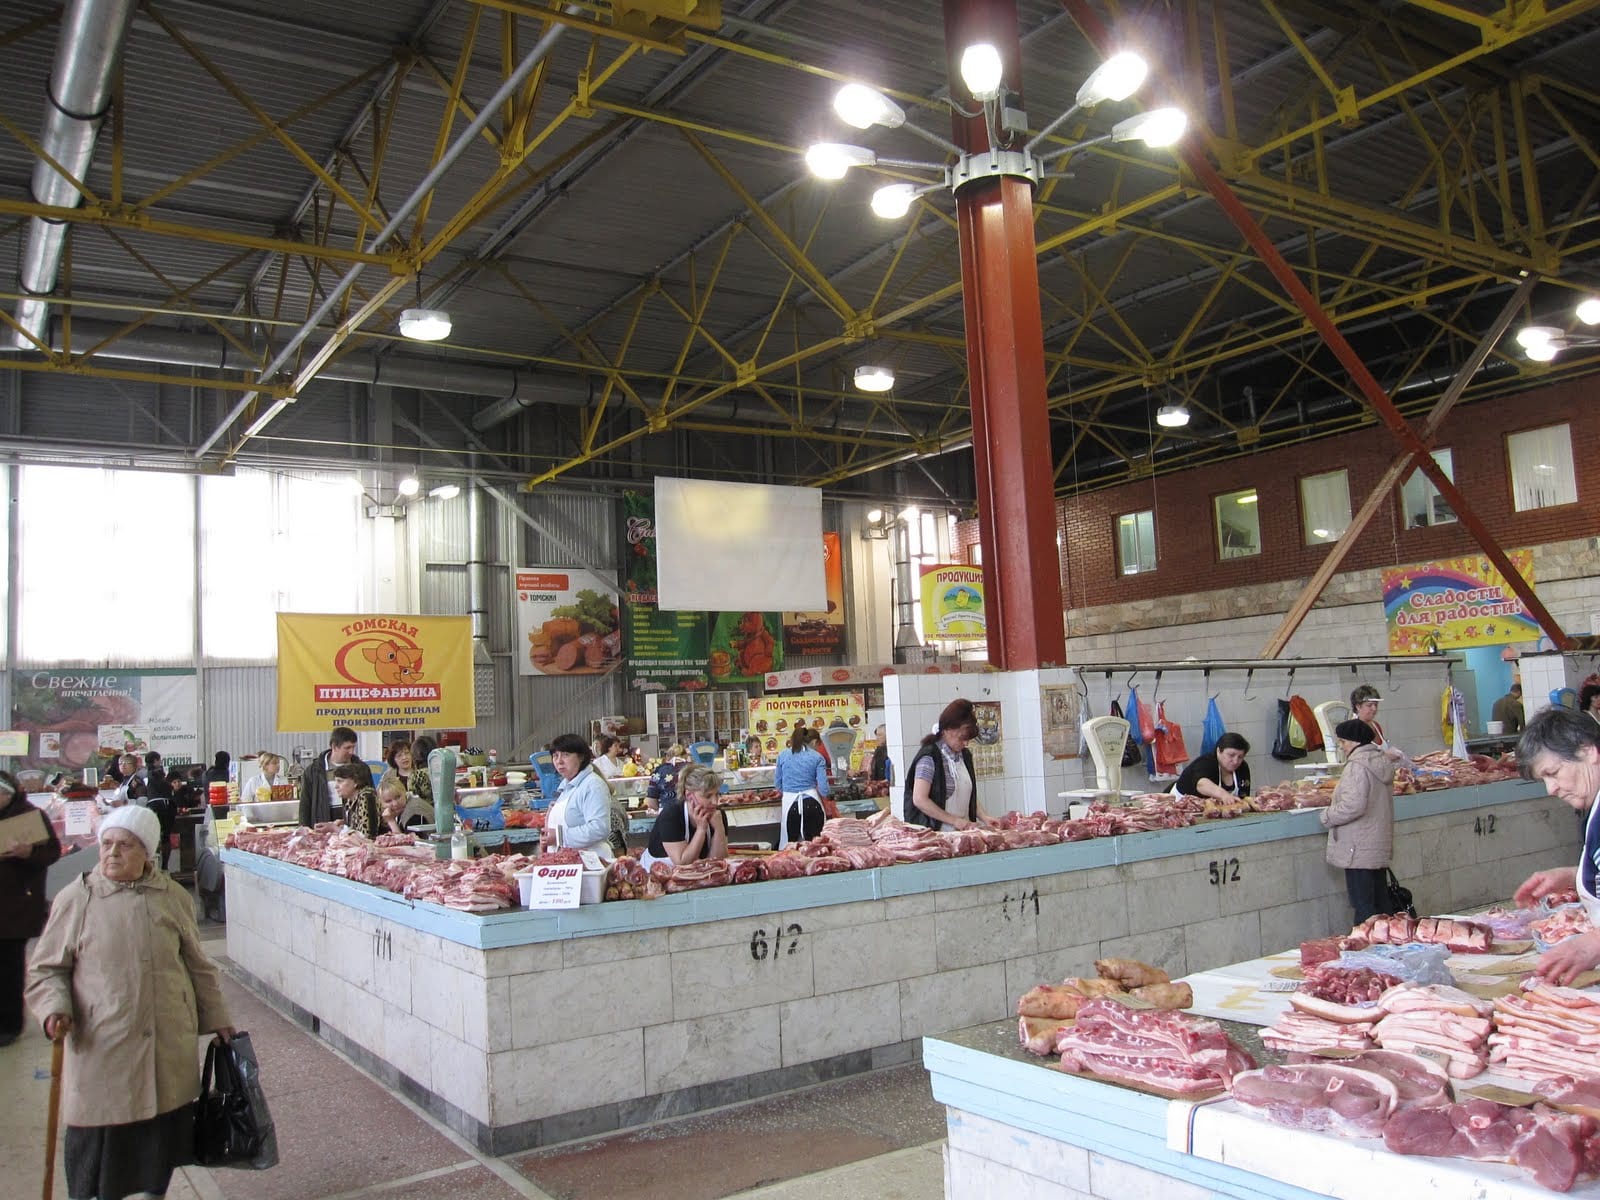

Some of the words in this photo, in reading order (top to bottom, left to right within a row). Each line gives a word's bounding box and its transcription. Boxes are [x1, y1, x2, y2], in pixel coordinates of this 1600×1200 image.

[1410, 586, 1502, 608] Сладости
[1396, 611, 1431, 626] для
[1435, 599, 1522, 625] радости!
[341, 618, 420, 638] ТОМСКАЯ
[31, 671, 118, 690] Свежие
[61, 687, 133, 697] впечатления!
[319, 687, 437, 701] ПТИЦЕФАБРИКА
[316, 707, 383, 717] ПРОДУКЦИЯ
[386, 706, 401, 715] ПО
[404, 705, 440, 716] ЦЕНАМ
[766, 698, 849, 711] ПОЛУФАБРИКАТЫ
[332, 717, 426, 727] ПРОИЗВОДИТЕЛЯ
[537, 867, 578, 880] Фарш
[1209, 857, 1241, 885] 5/2
[750, 923, 803, 961] 6/2
